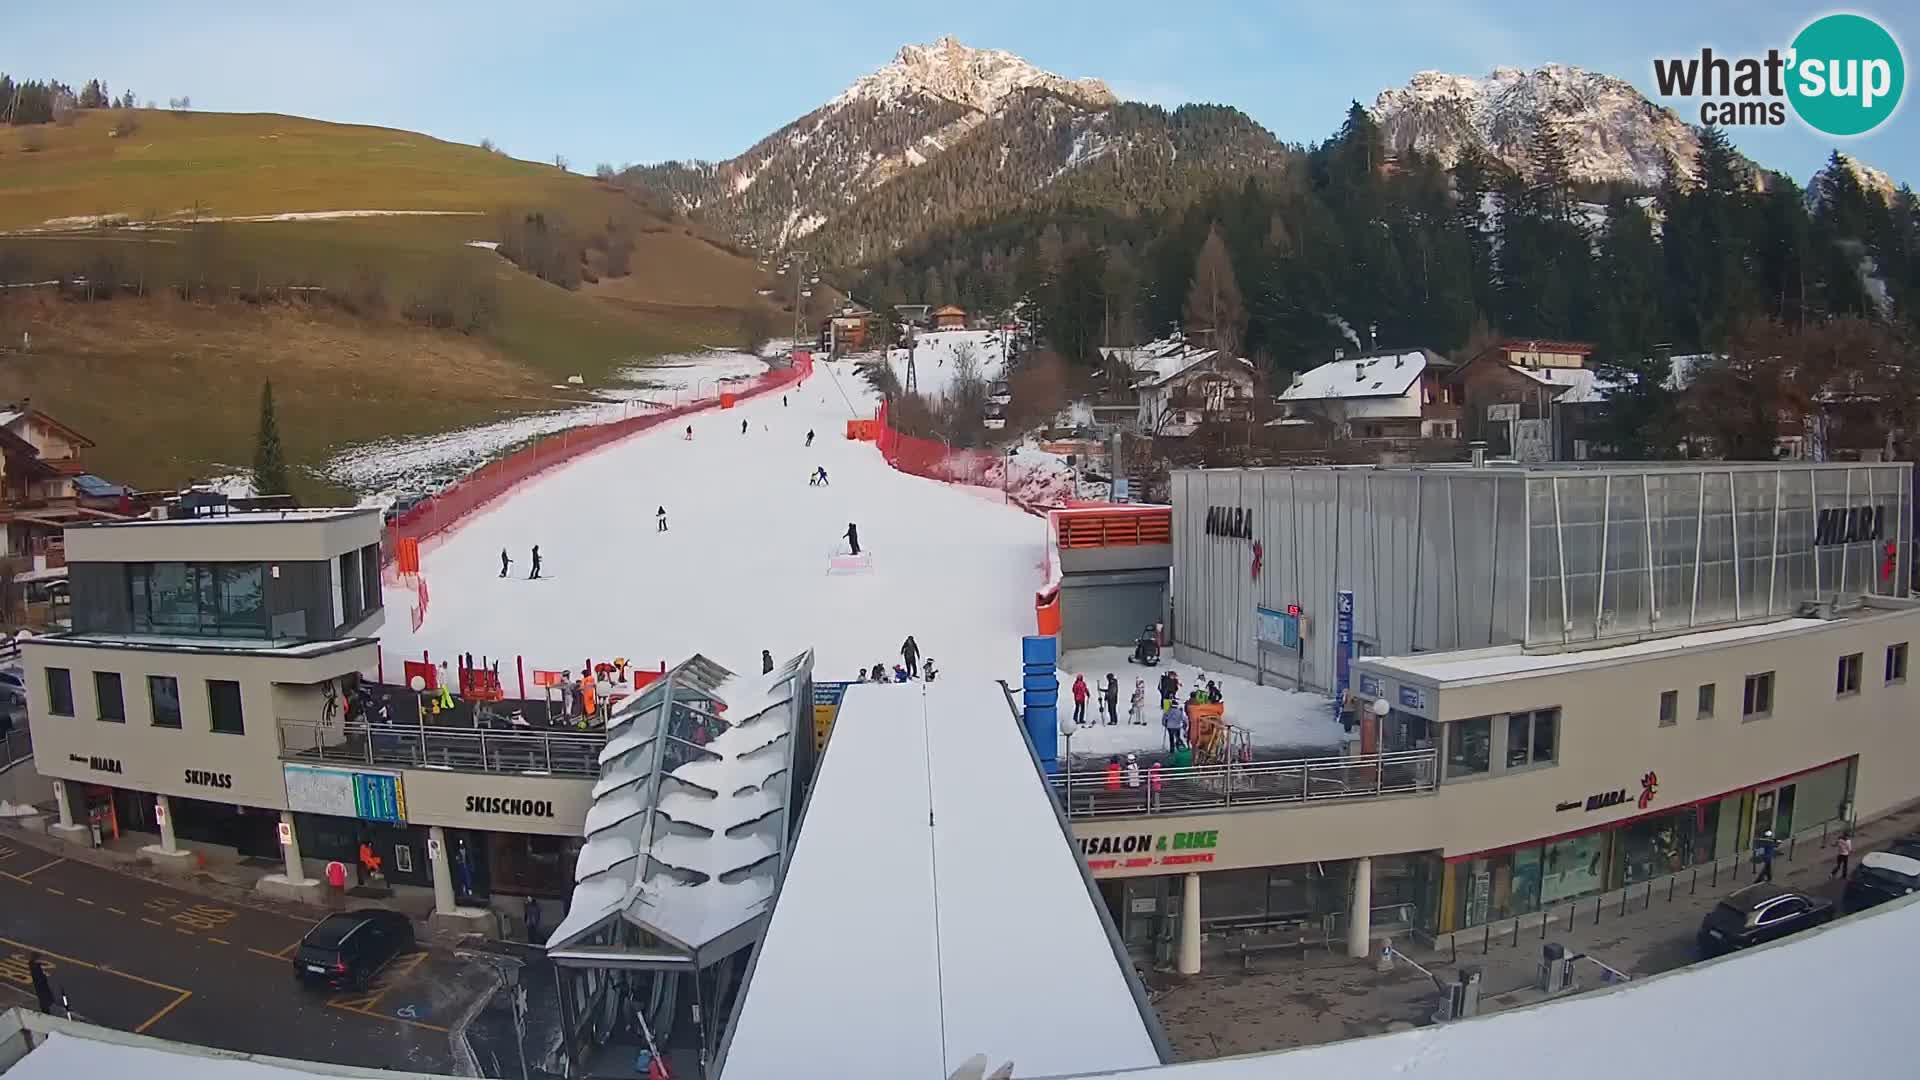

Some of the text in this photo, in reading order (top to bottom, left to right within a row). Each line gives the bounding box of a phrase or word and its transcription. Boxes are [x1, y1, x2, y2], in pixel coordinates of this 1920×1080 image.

[1206, 506, 1252, 540] MIARA
[185, 769, 233, 789] SKIPASS
[465, 796, 555, 818] SKISCHOOL
[1076, 835, 1152, 855] ISALON
[1172, 830, 1218, 850] BIKE
